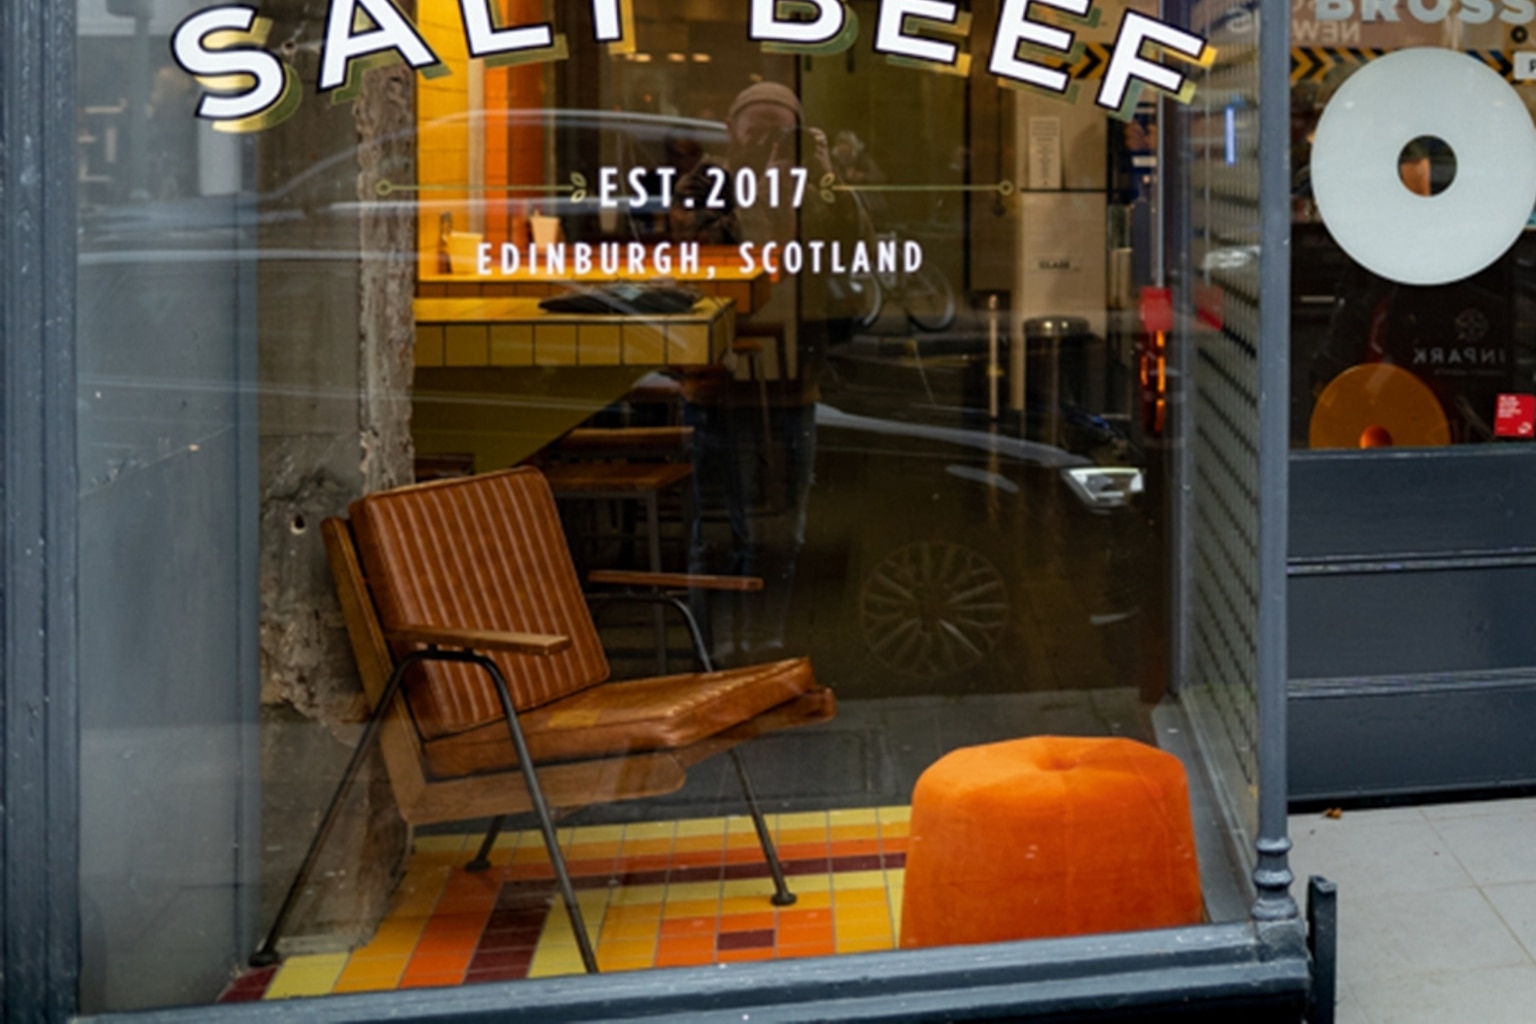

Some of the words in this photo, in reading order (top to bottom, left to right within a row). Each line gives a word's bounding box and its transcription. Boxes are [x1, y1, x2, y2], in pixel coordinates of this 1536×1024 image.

[599, 167, 808, 208] EST.2017
[476, 242, 716, 279] EDINBURGH,
[739, 240, 922, 274] SCOTLAND
